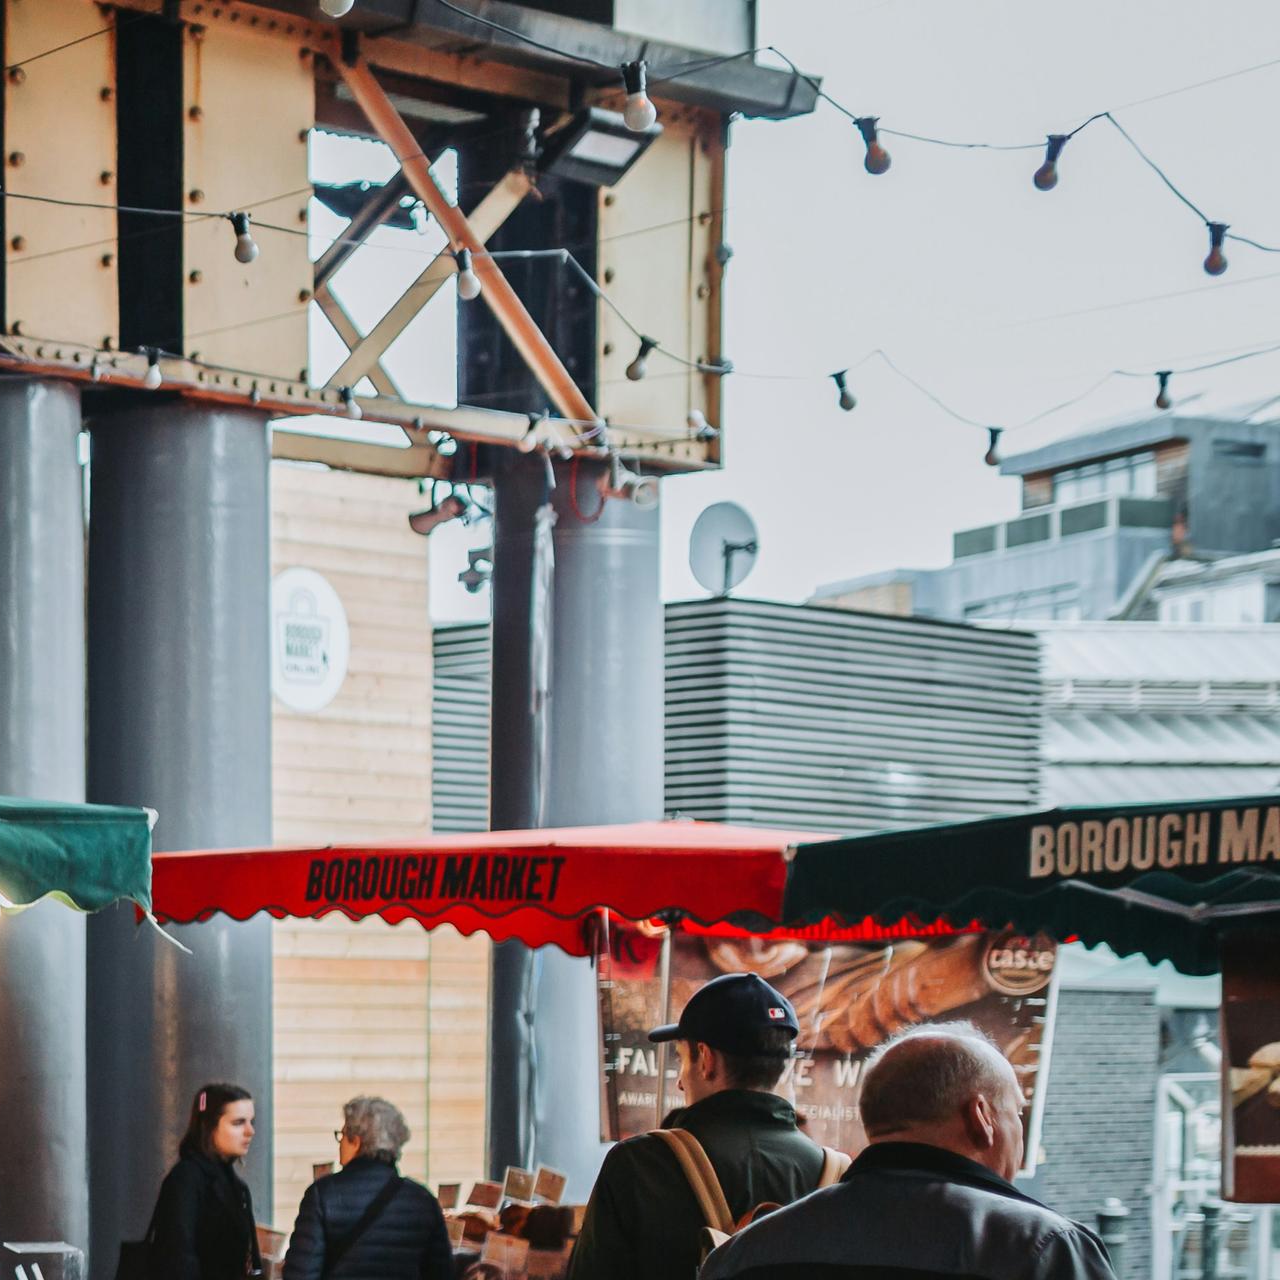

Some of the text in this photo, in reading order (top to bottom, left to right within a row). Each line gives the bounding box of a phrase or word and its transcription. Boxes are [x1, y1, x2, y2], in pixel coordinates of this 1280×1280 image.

[1029, 812, 1210, 878] BOROUGH
[305, 856, 566, 901] BOROUGH MARKET
